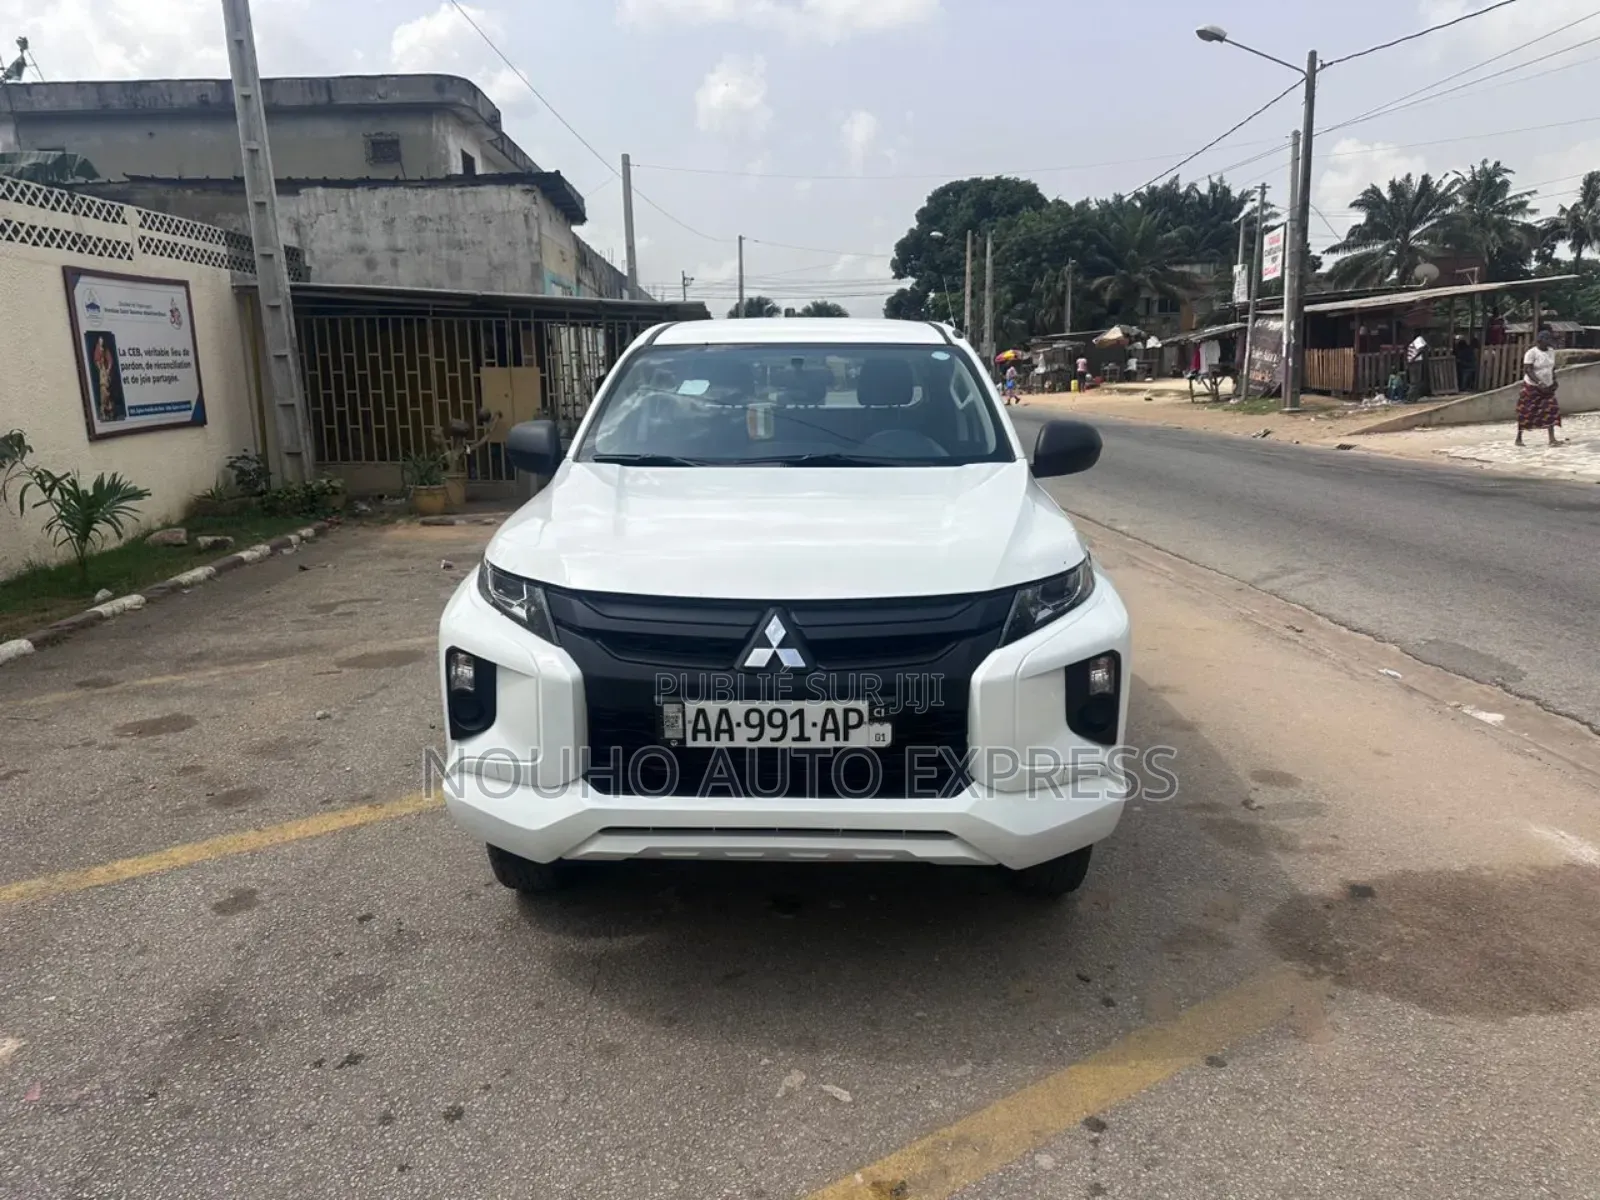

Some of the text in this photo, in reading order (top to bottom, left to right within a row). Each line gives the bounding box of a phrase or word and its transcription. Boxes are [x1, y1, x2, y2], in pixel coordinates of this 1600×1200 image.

[118, 347, 126, 356] La
[182, 348, 190, 356] de
[145, 361, 153, 370] de
[123, 375, 130, 385] et
[130, 374, 139, 384] de
